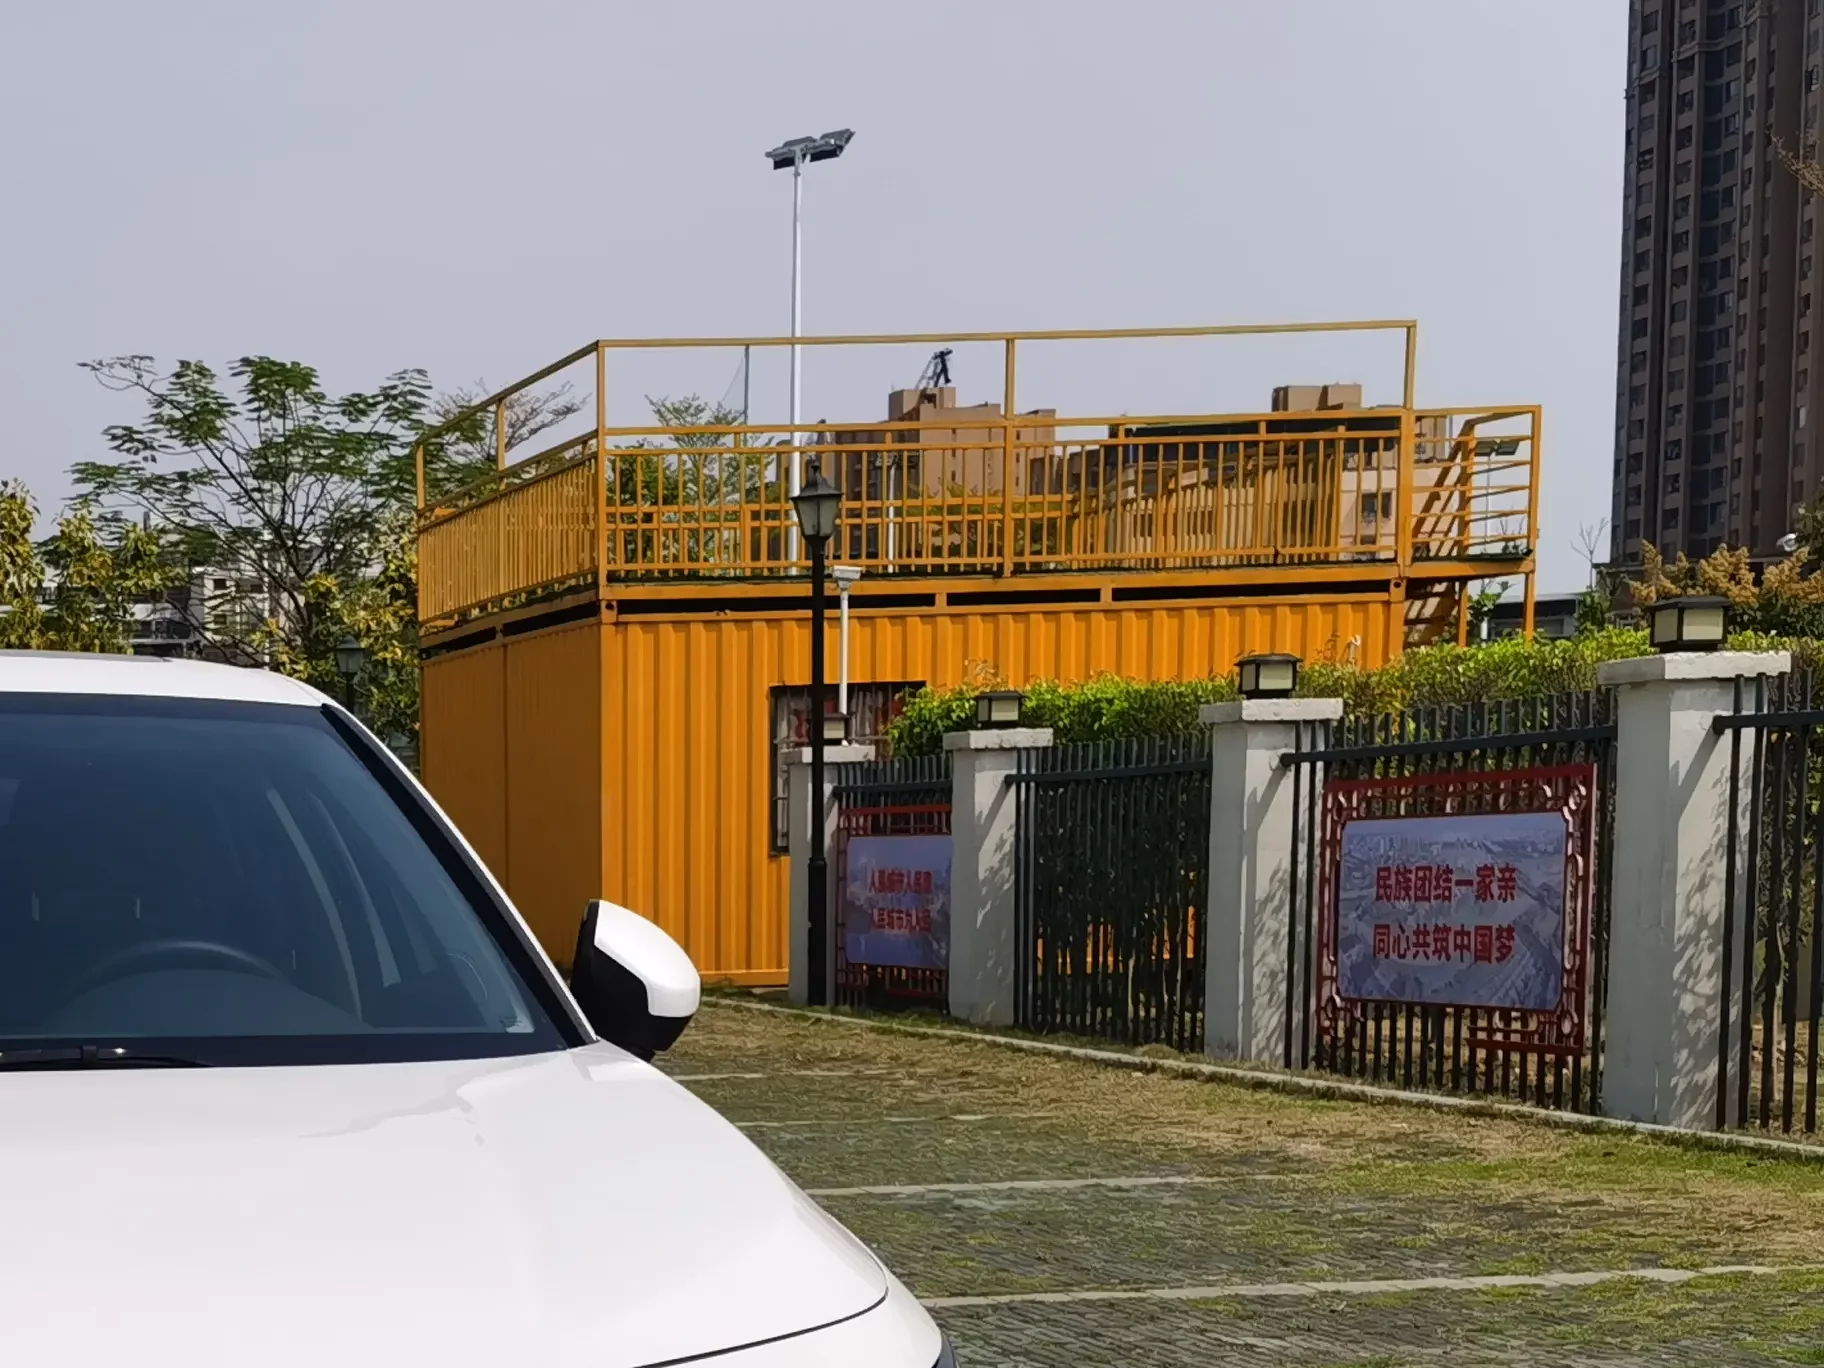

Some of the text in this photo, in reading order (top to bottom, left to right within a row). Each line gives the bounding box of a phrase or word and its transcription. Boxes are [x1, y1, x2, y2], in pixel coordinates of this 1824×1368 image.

[1376, 863, 1517, 903] 民族团结一家亲
[1373, 923, 1516, 964] 同心共筑中国梦
